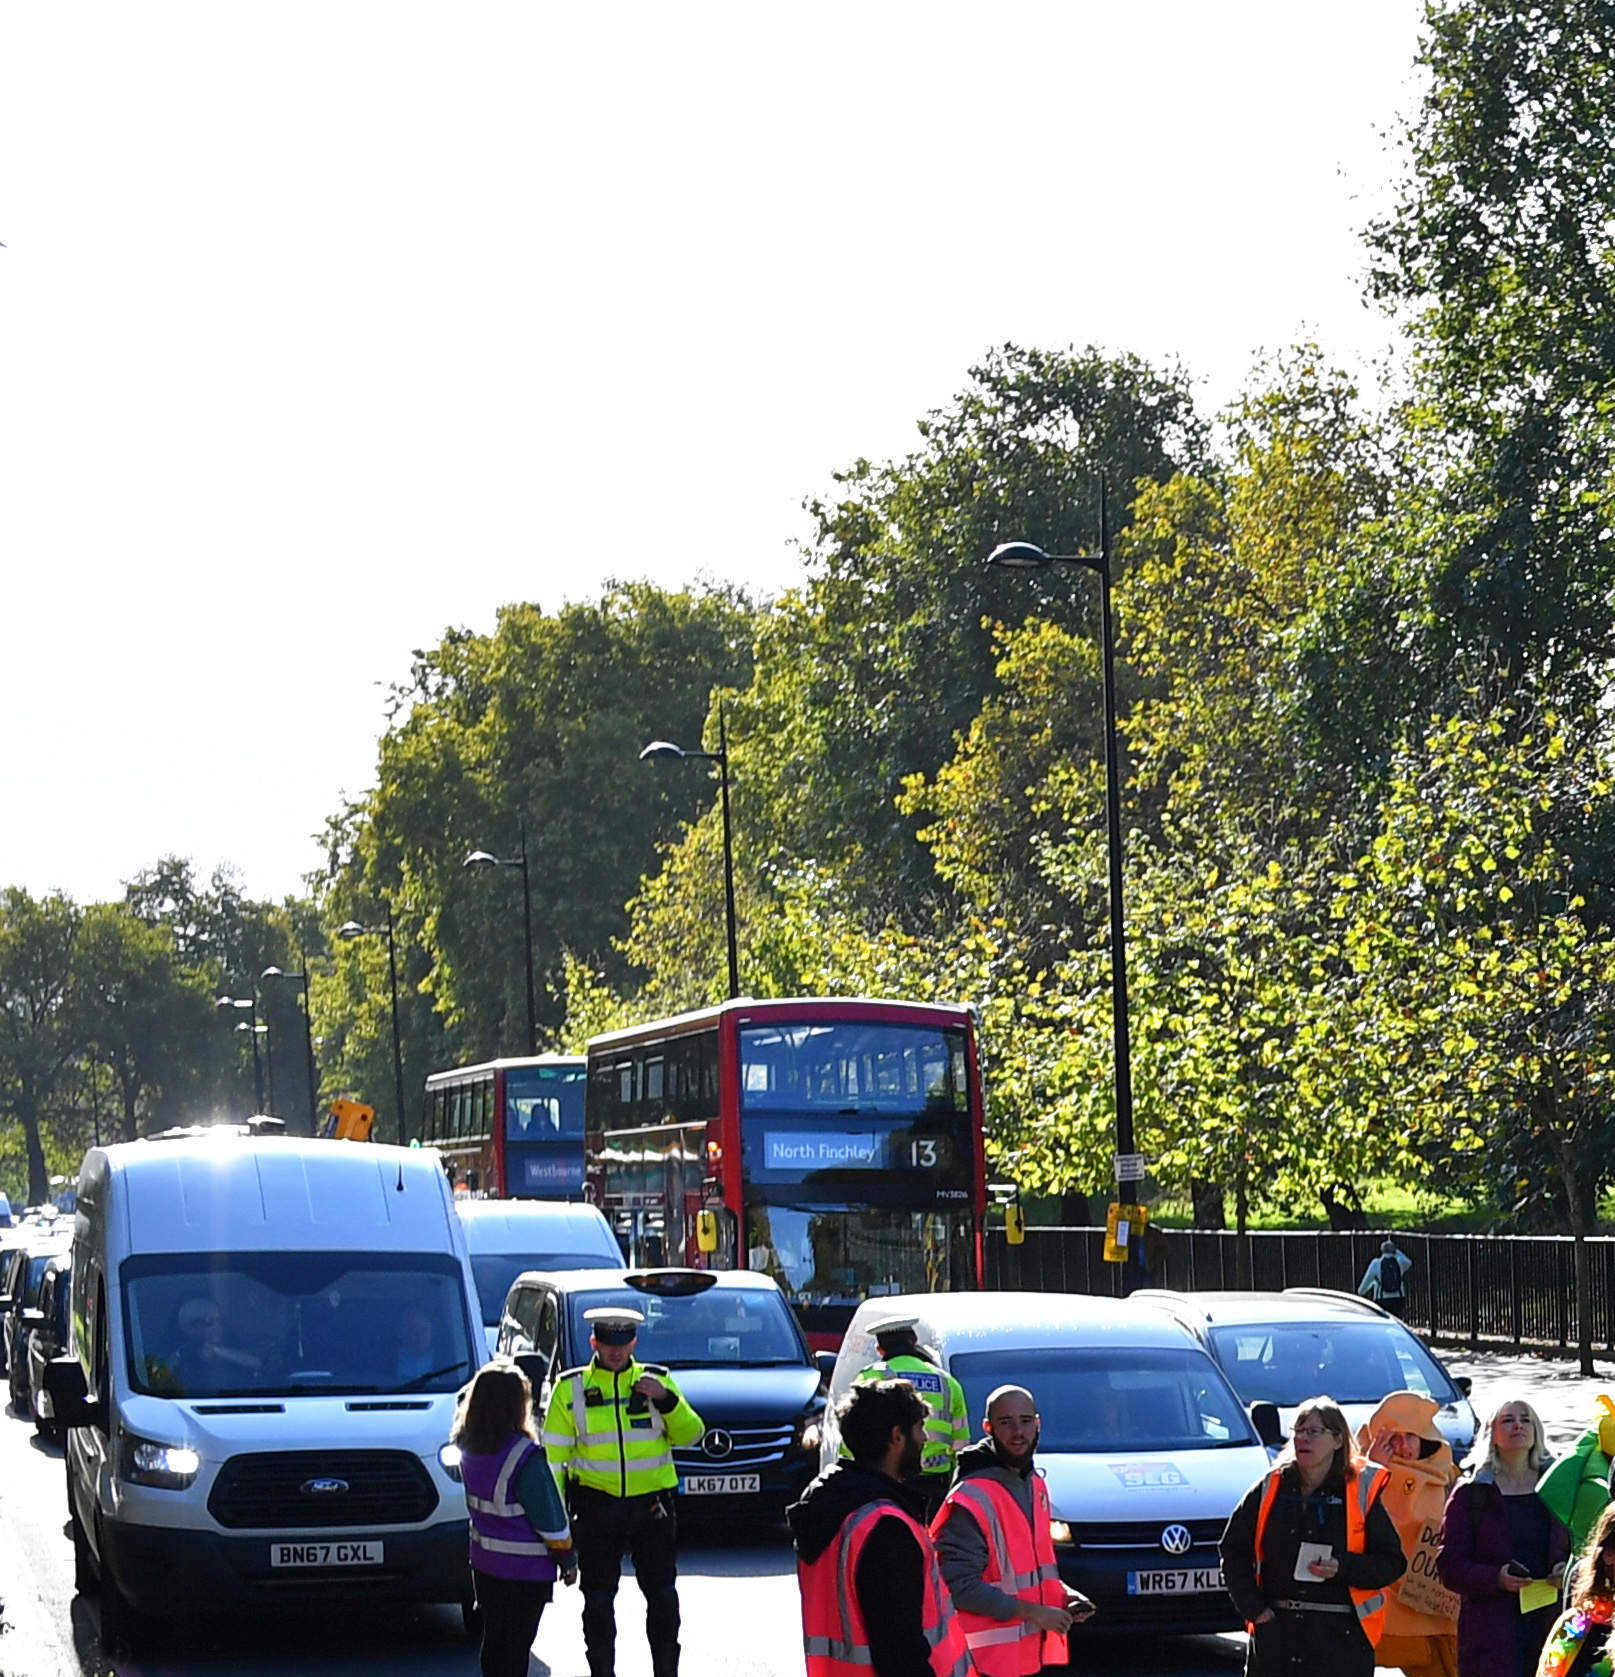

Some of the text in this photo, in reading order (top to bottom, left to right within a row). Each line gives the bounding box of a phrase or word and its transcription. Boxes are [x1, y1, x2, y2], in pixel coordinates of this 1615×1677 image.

[772, 1142, 875, 1164] North Finchley
[911, 1140, 937, 1167] 13
[530, 1164, 582, 1177] Westbourne
[915, 1379, 939, 1391] LICE
[687, 1475, 759, 1494] LK67 OTZ
[279, 1544, 375, 1564] BN67 GXL
[1139, 1572, 1189, 1591] WR67
